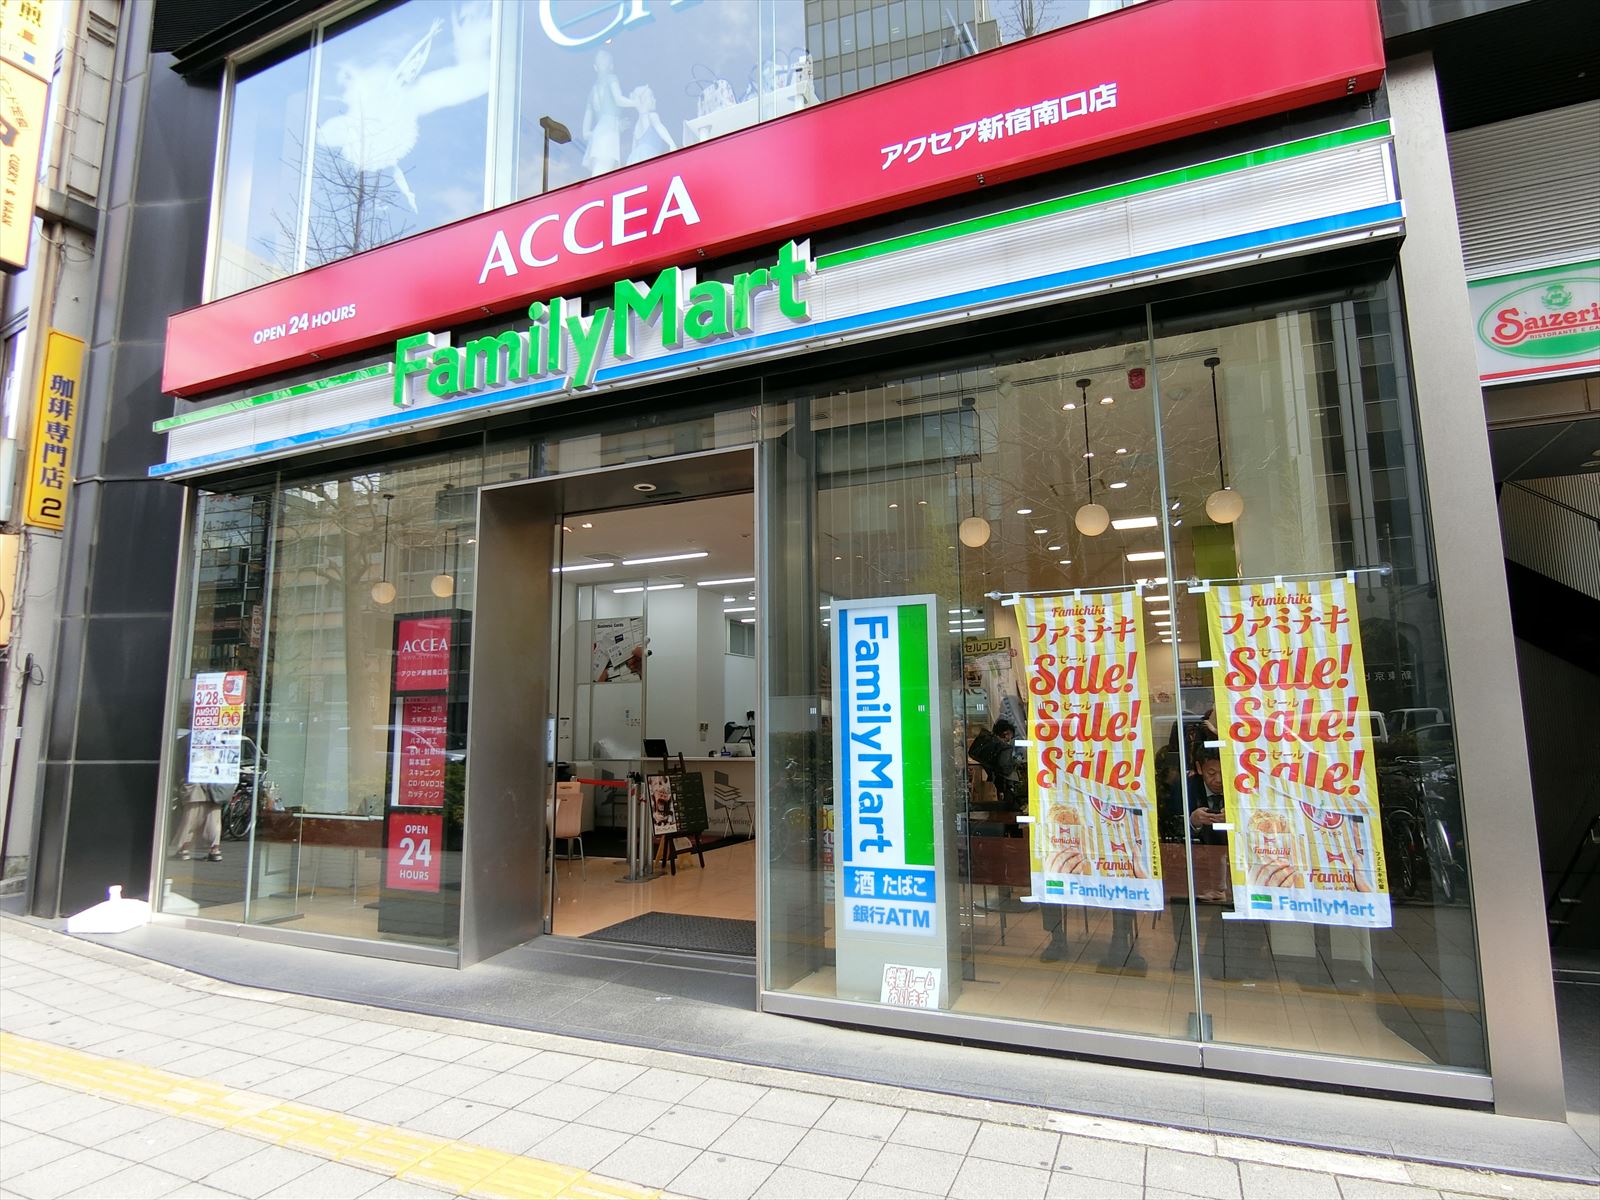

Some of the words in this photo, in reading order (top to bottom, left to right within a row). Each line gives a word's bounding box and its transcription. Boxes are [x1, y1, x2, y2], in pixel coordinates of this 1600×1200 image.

[880, 82, 1118, 171] アクセア新宿南口店
[478, 175, 702, 285] ACCEA
[253, 323, 286, 345] OPEN
[288, 312, 309, 335] 24
[311, 303, 356, 329] HOURS
[392, 239, 813, 408] FamilyMart
[1494, 302, 1600, 341] Saizeri
[41, 374, 76, 490] 珈琲専門店
[41, 497, 63, 519] 2
[1051, 604, 1106, 618] Famichiki
[1249, 592, 1312, 607] Famichiki
[1025, 615, 1137, 646] ファミチキ
[1218, 605, 1350, 637] ファミチキ
[402, 637, 449, 654] ACCEA
[1029, 651, 1138, 696] Sale!
[1224, 644, 1353, 692] Sale!
[851, 615, 893, 854] FamilyMart
[1034, 699, 1142, 742] Sale!
[1228, 696, 1360, 743] Sale!
[1036, 746, 1145, 791] Sale!
[1233, 747, 1366, 796] Sale!
[404, 824, 429, 835] OPEN
[399, 837, 432, 867] 24
[399, 869, 430, 880] HOURS
[854, 869, 876, 897] 酒
[882, 874, 928, 897] たばこ
[1069, 881, 1151, 901] FamilyMart
[853, 904, 931, 929] 銀行ATM
[1278, 895, 1376, 917] FamilyMart
